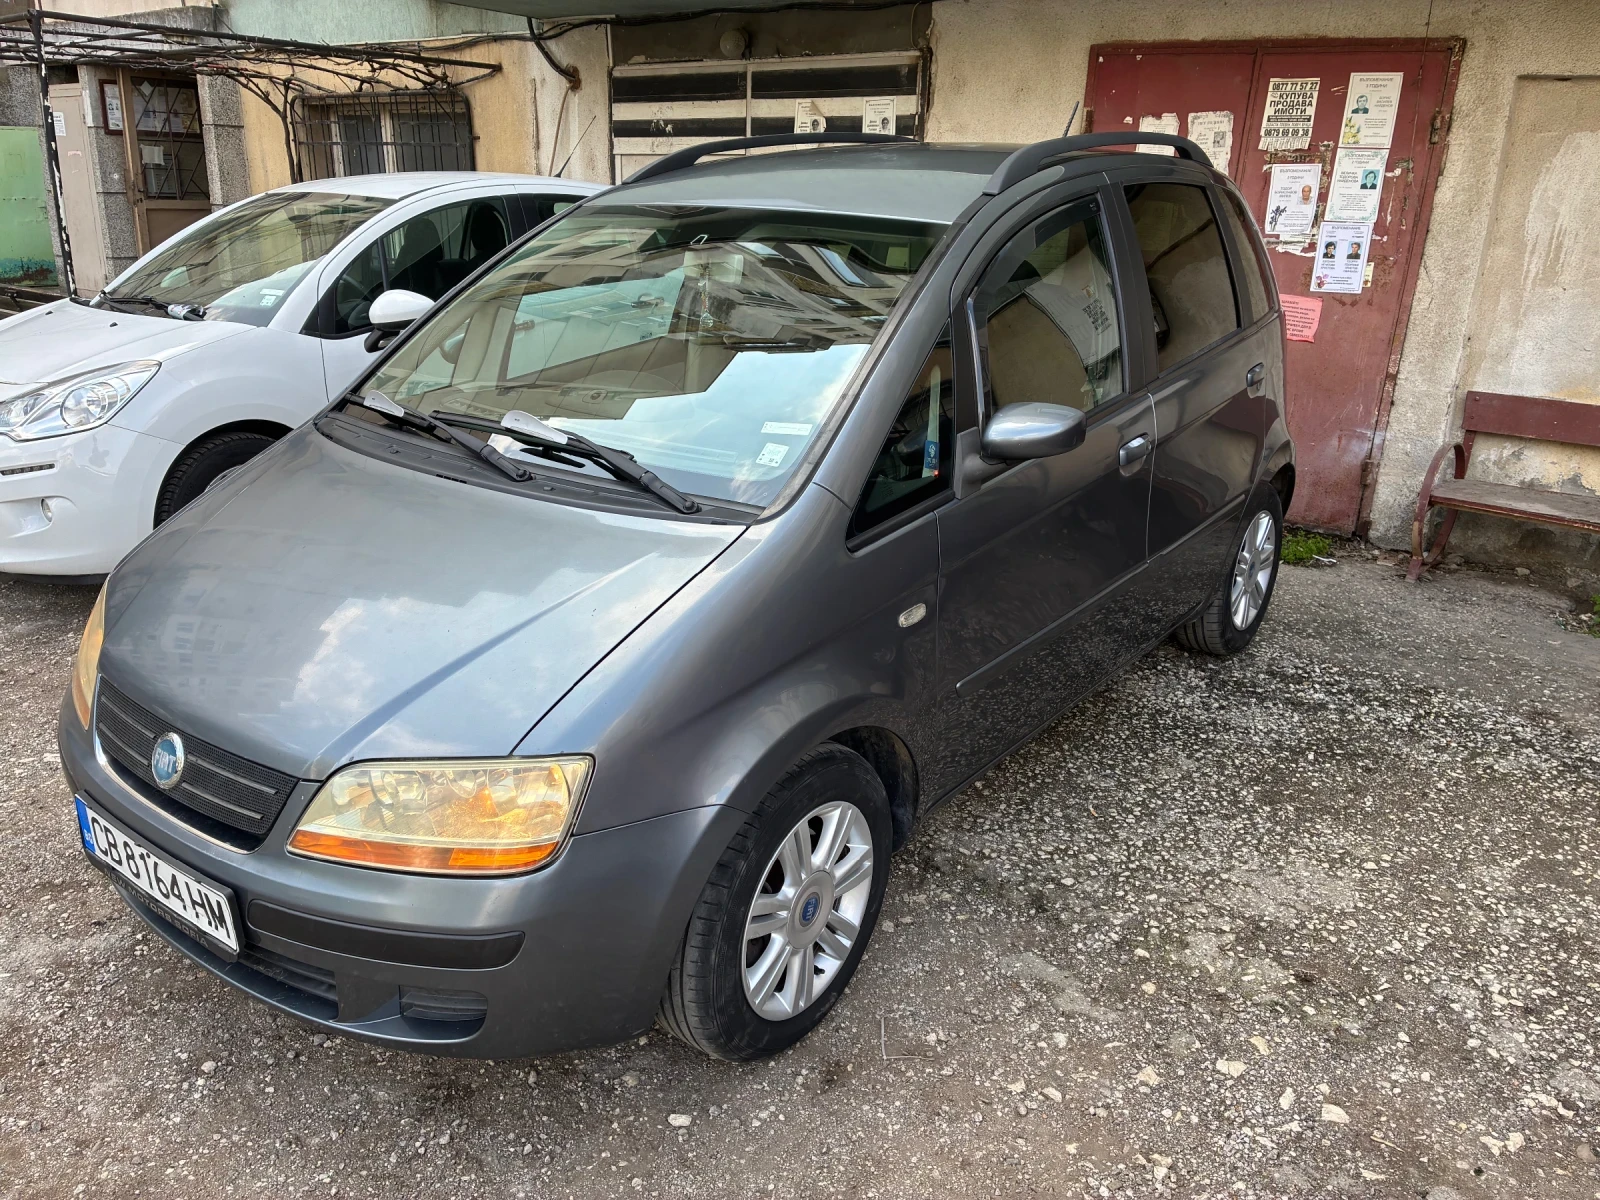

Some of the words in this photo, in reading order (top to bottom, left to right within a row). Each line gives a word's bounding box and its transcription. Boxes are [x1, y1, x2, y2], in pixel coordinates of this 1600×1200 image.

[1272, 82, 1289, 91] 0877
[1290, 82, 1298, 91] 77
[1299, 82, 1309, 91] 57
[1309, 81, 1318, 90] 27
[1278, 92, 1314, 100] КУПУВА
[1269, 100, 1313, 108] ПРОДАВА
[1264, 128, 1280, 137] 0879
[1281, 128, 1290, 137] 69
[1291, 128, 1300, 137] 09
[1301, 128, 1310, 137] 38
[154, 747, 176, 773] FIAT
[104, 868, 127, 890] NEW
[128, 886, 173, 924] MOTORS
[174, 918, 209, 948] SOFIA
[805, 898, 815, 919] FIAT
